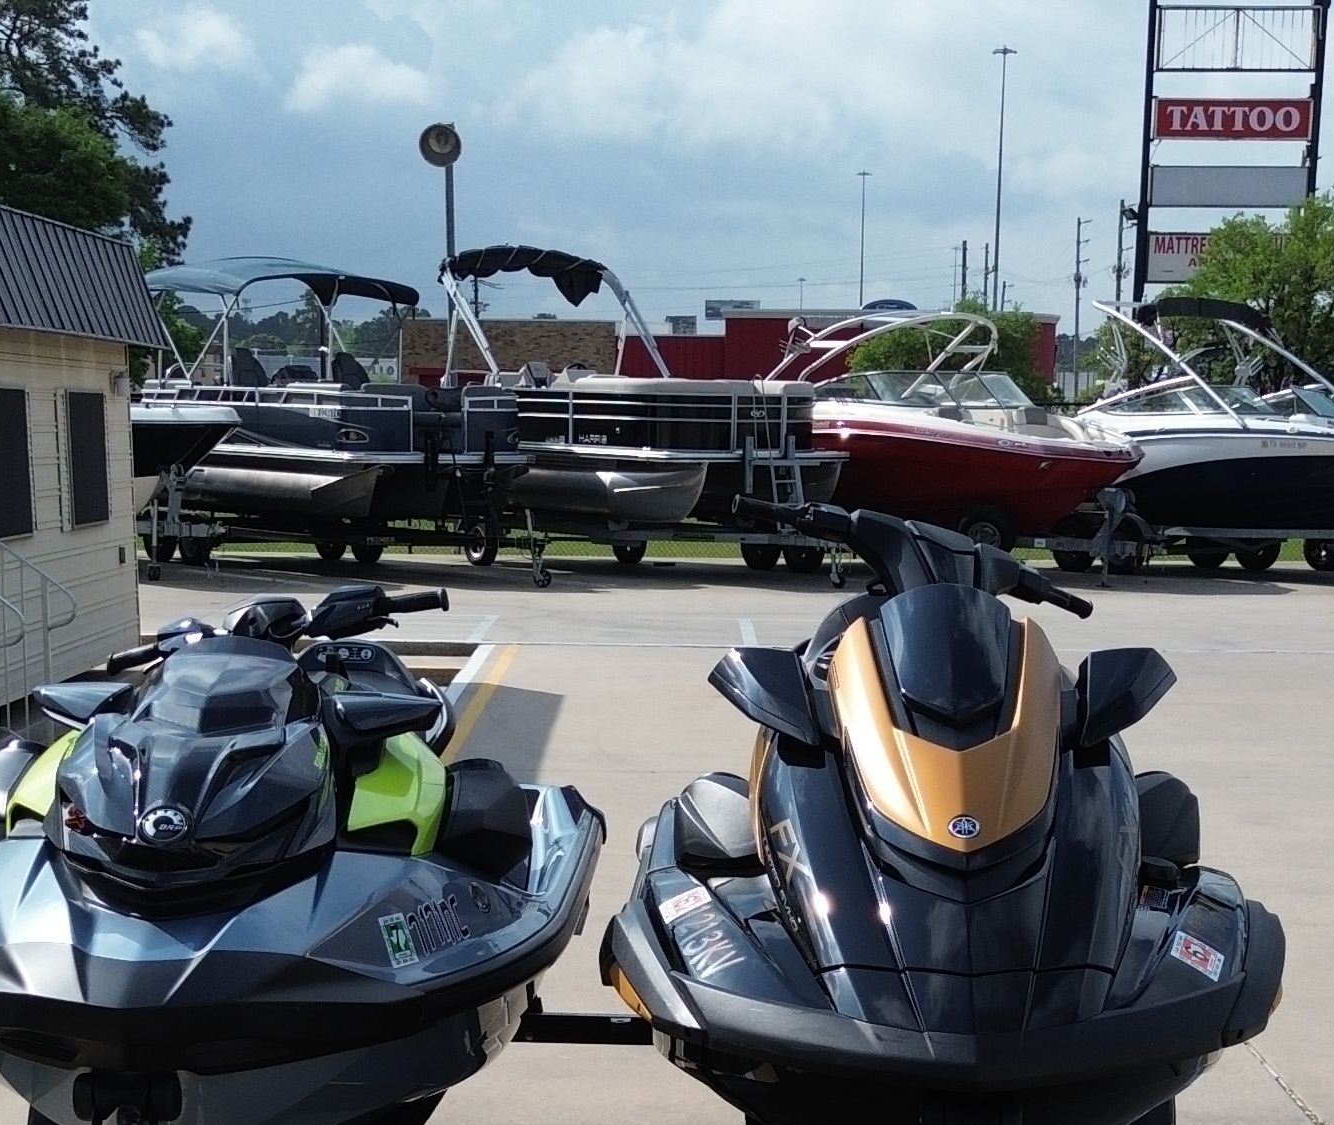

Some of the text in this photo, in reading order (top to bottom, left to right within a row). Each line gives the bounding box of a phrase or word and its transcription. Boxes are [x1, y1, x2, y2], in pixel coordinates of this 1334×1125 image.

[1167, 106, 1300, 131] TATTOO
[159, 823, 182, 831] BRP
[770, 819, 811, 887] FX
